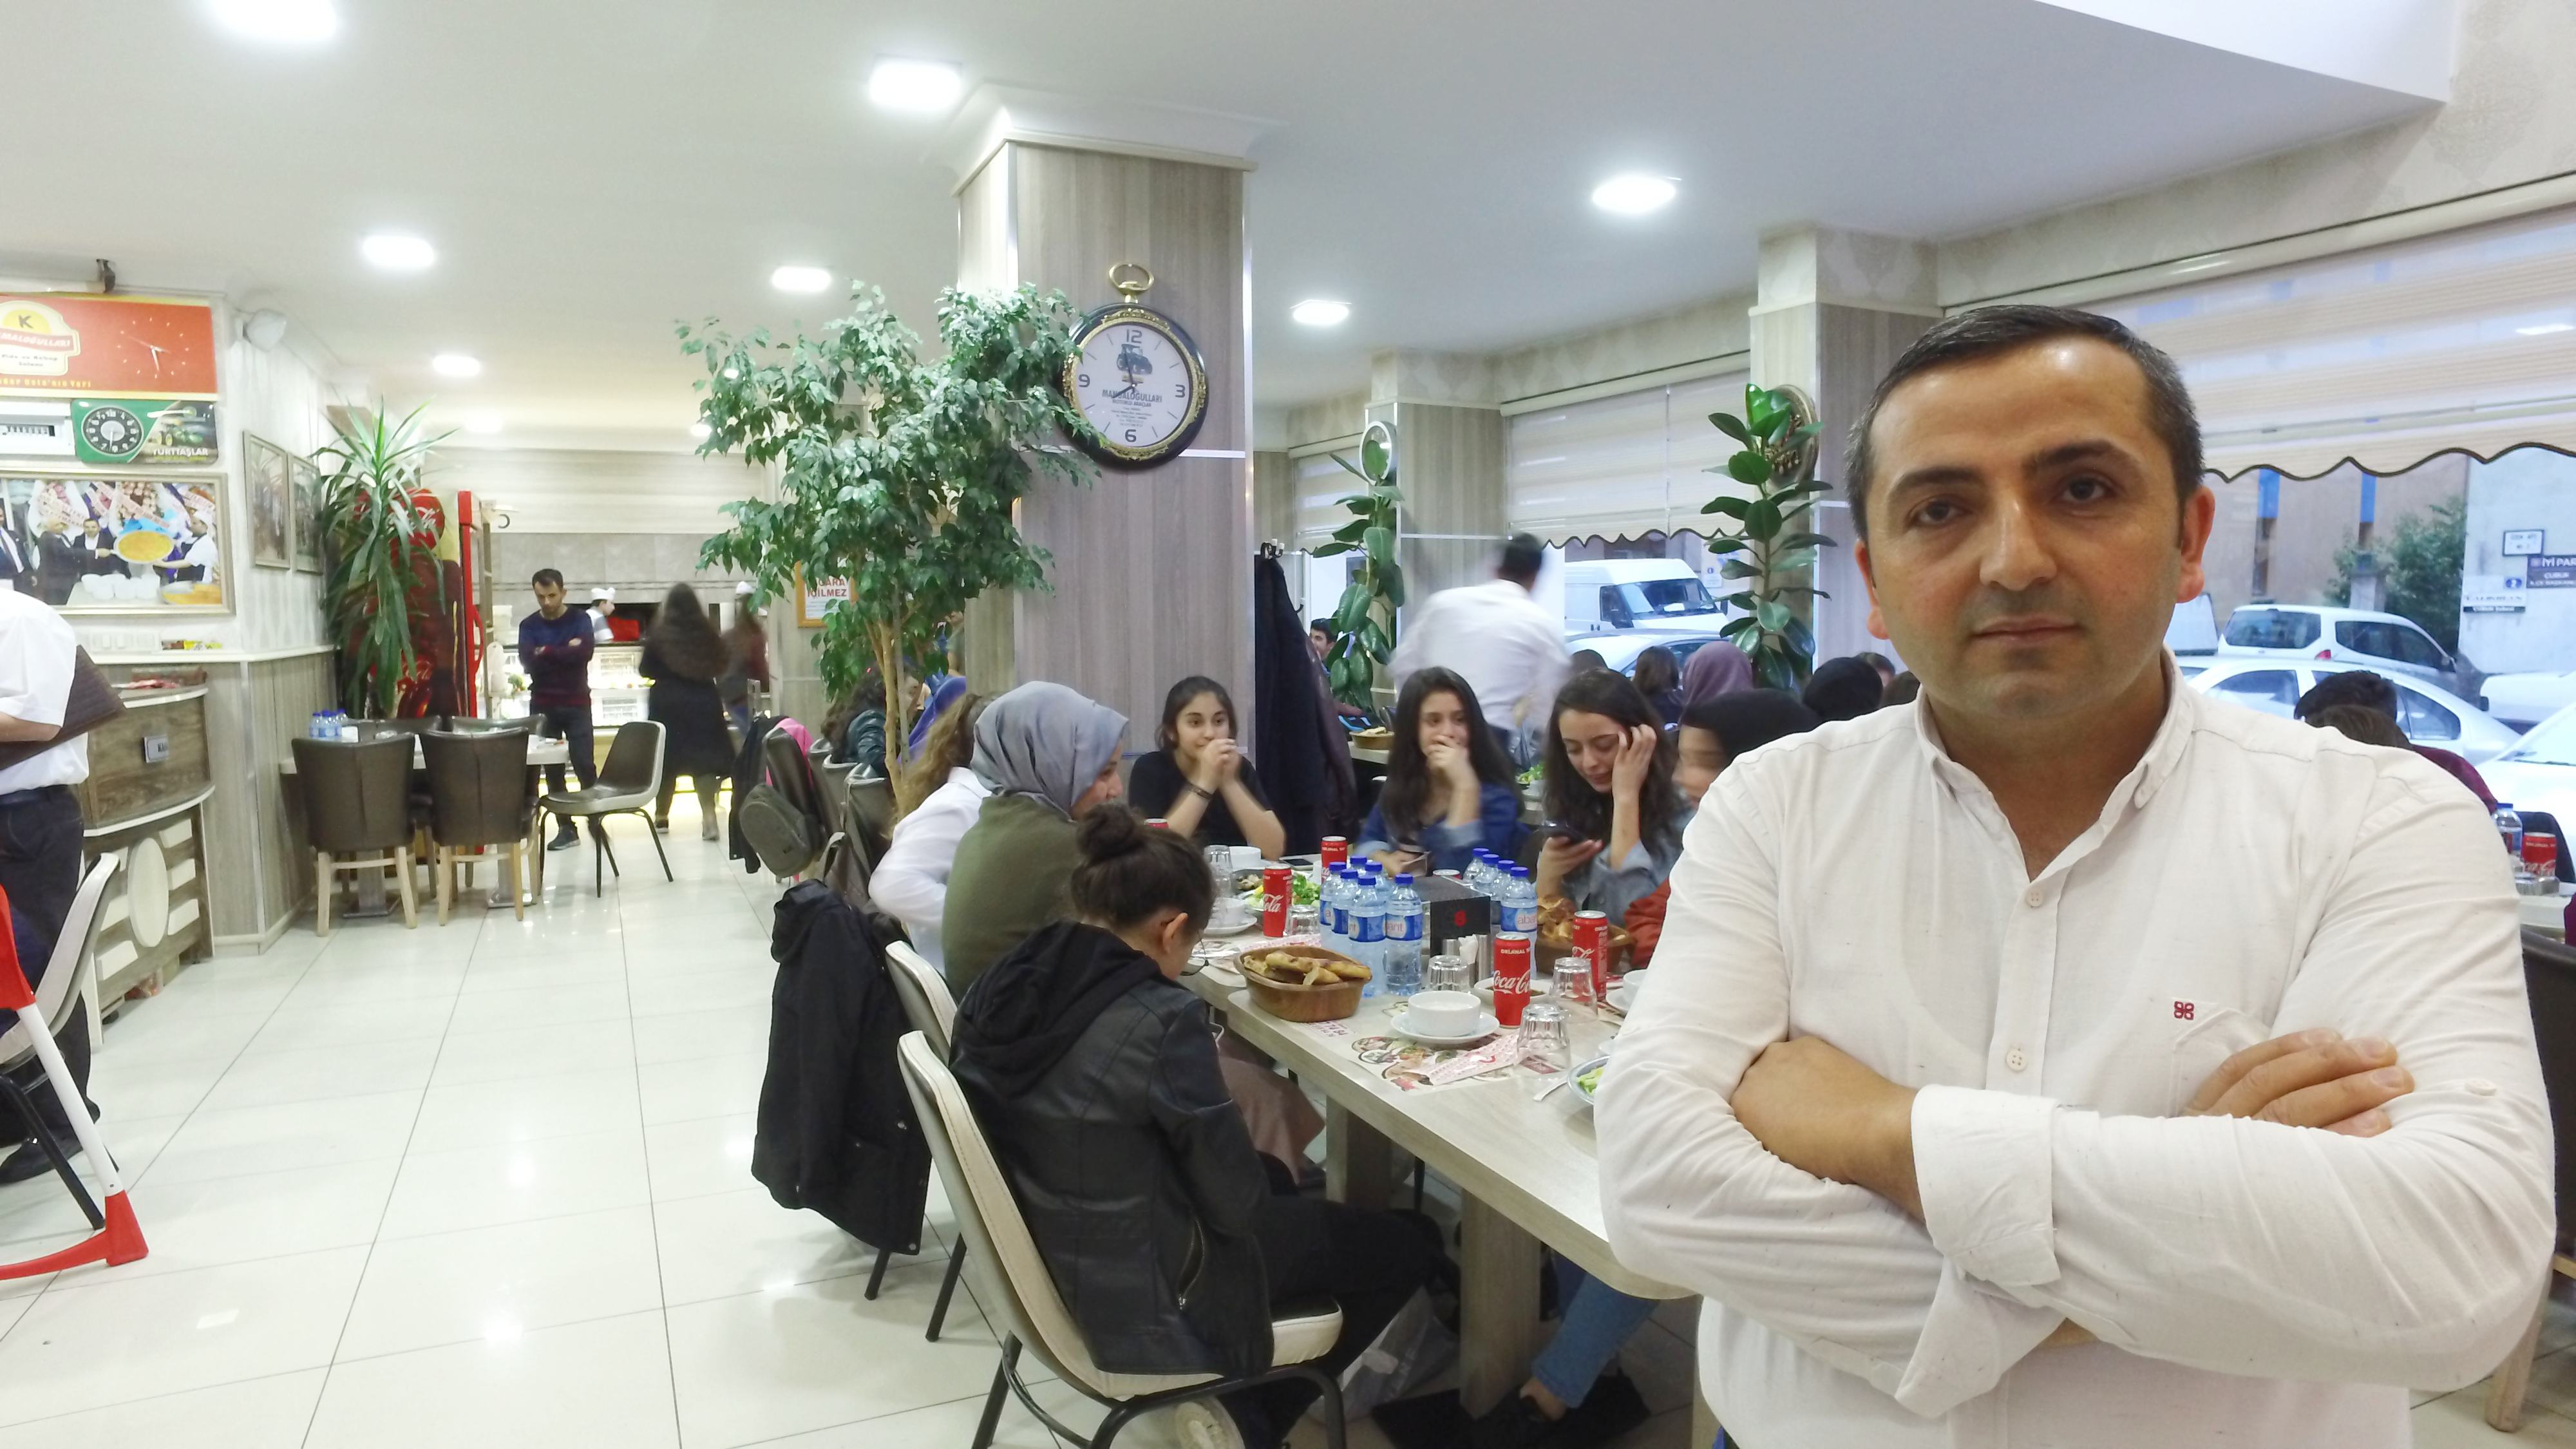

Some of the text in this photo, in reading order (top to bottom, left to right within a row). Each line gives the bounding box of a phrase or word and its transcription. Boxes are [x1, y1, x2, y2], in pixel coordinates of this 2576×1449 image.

[18, 315, 33, 329] K
[1126, 329, 1142, 344] 12
[1078, 374, 1091, 388] 9
[1175, 384, 1186, 399] 3
[1125, 429, 1137, 443] 6
